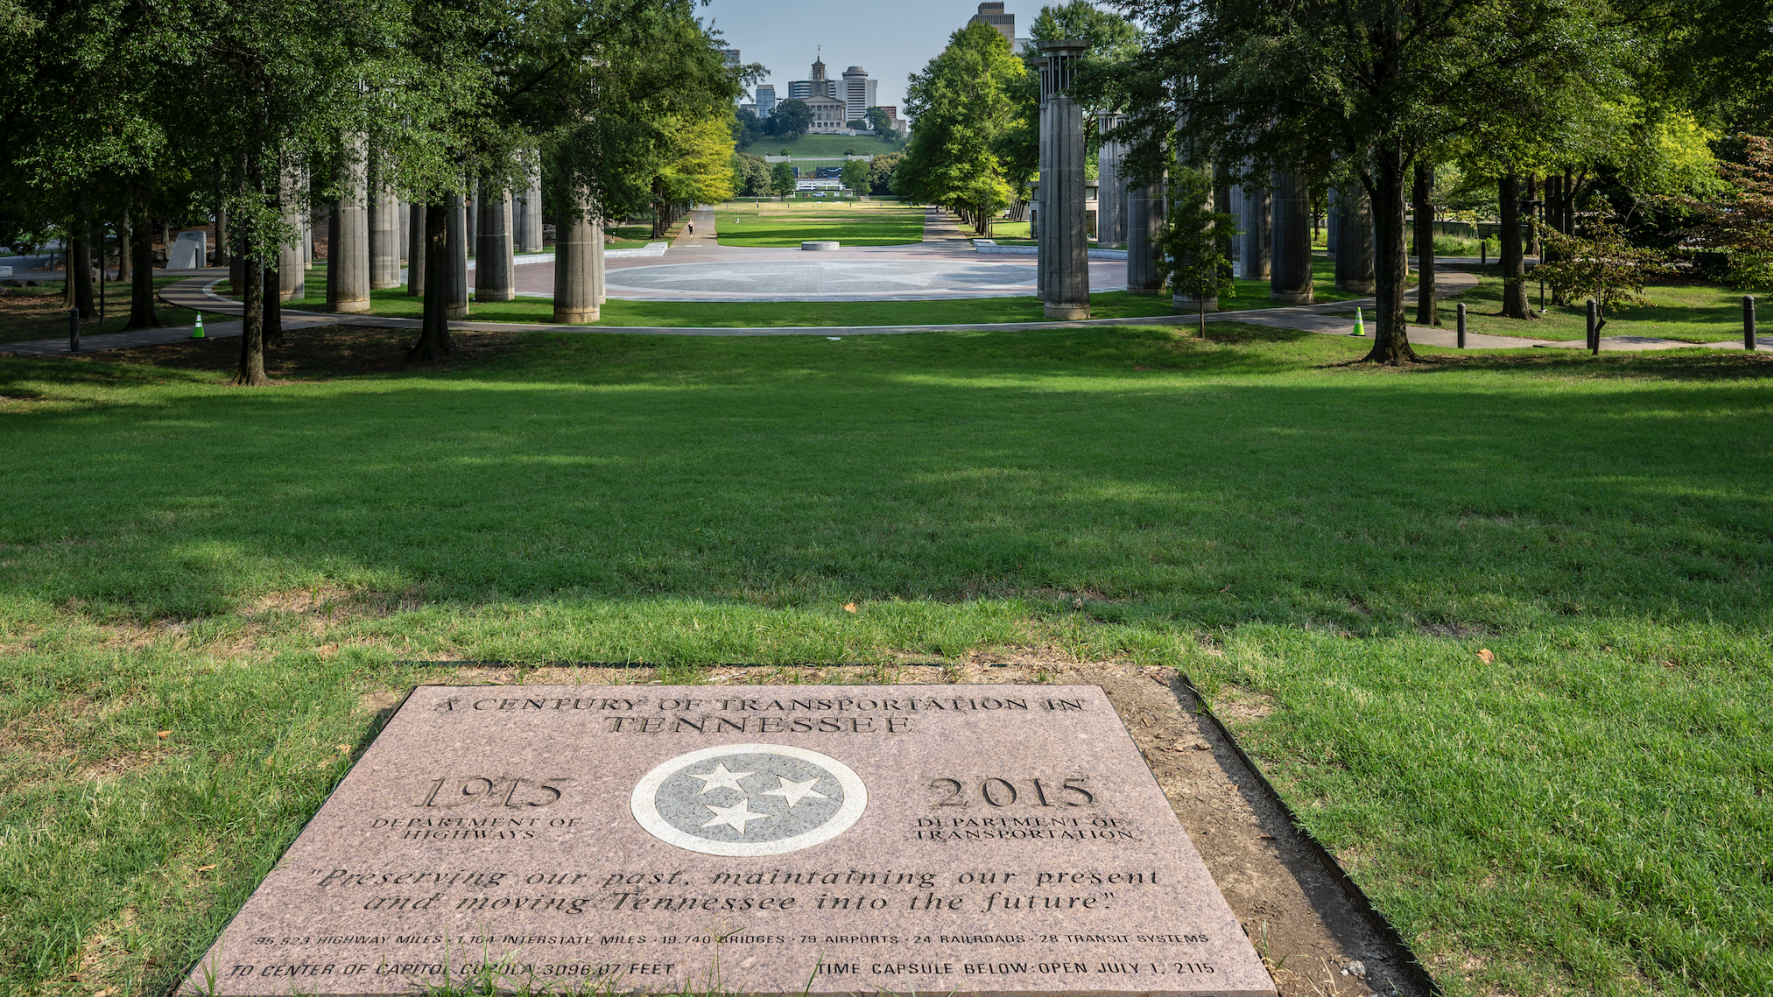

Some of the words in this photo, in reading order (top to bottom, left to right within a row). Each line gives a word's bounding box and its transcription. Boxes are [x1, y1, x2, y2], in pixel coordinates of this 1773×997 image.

[433, 698, 459, 711] A
[472, 698, 642, 711] CENTURY
[657, 698, 701, 711] OF
[716, 698, 1029, 711] TRANSPORTATION
[1041, 698, 1087, 711] IN
[604, 715, 914, 733] TENNESSEE
[413, 776, 573, 808] 1915
[929, 777, 1094, 808] 2015
[371, 817, 540, 828] DEPARTMENT
[549, 817, 581, 828] OF
[915, 817, 1079, 828] DEPARTMENT
[1092, 817, 1129, 828] OF
[403, 829, 536, 840] HIGHWAYS
[914, 829, 1134, 840] TRANSPORTATION
[310, 868, 507, 889] "Preserving
[525, 872, 588, 885] our
[602, 869, 690, 889] past,
[712, 869, 937, 889] maintaining
[957, 871, 1018, 885] our
[1036, 869, 1159, 888] present
[362, 892, 443, 910] and
[455, 893, 590, 915] moving
[612, 892, 796, 911] Tennessee
[816, 892, 888, 910] into
[909, 892, 964, 910] the
[316, 935, 390, 945] HIGHWAY
[396, 935, 443, 945] MILES
[502, 935, 594, 945] INTERSTATE
[600, 935, 647, 945] MILES
[719, 935, 785, 945] BRIDGES
[800, 935, 817, 944] 79
[825, 935, 899, 944] AIRPORTS
[913, 934, 931, 944] 24
[940, 934, 1026, 944] RAILROADS
[1039, 934, 1059, 944] 28
[1067, 934, 1130, 944] TRANSIT
[1137, 934, 1209, 944] SYSTEMS
[229, 964, 254, 977] TO
[261, 963, 335, 977] CENTER
[342, 963, 368, 975] OF
[629, 963, 675, 975] FEET
[816, 963, 861, 975] TIME
[872, 963, 953, 975] CAPSULE
[1098, 962, 1141, 974] JULY
[1176, 962, 1215, 974] 2115
